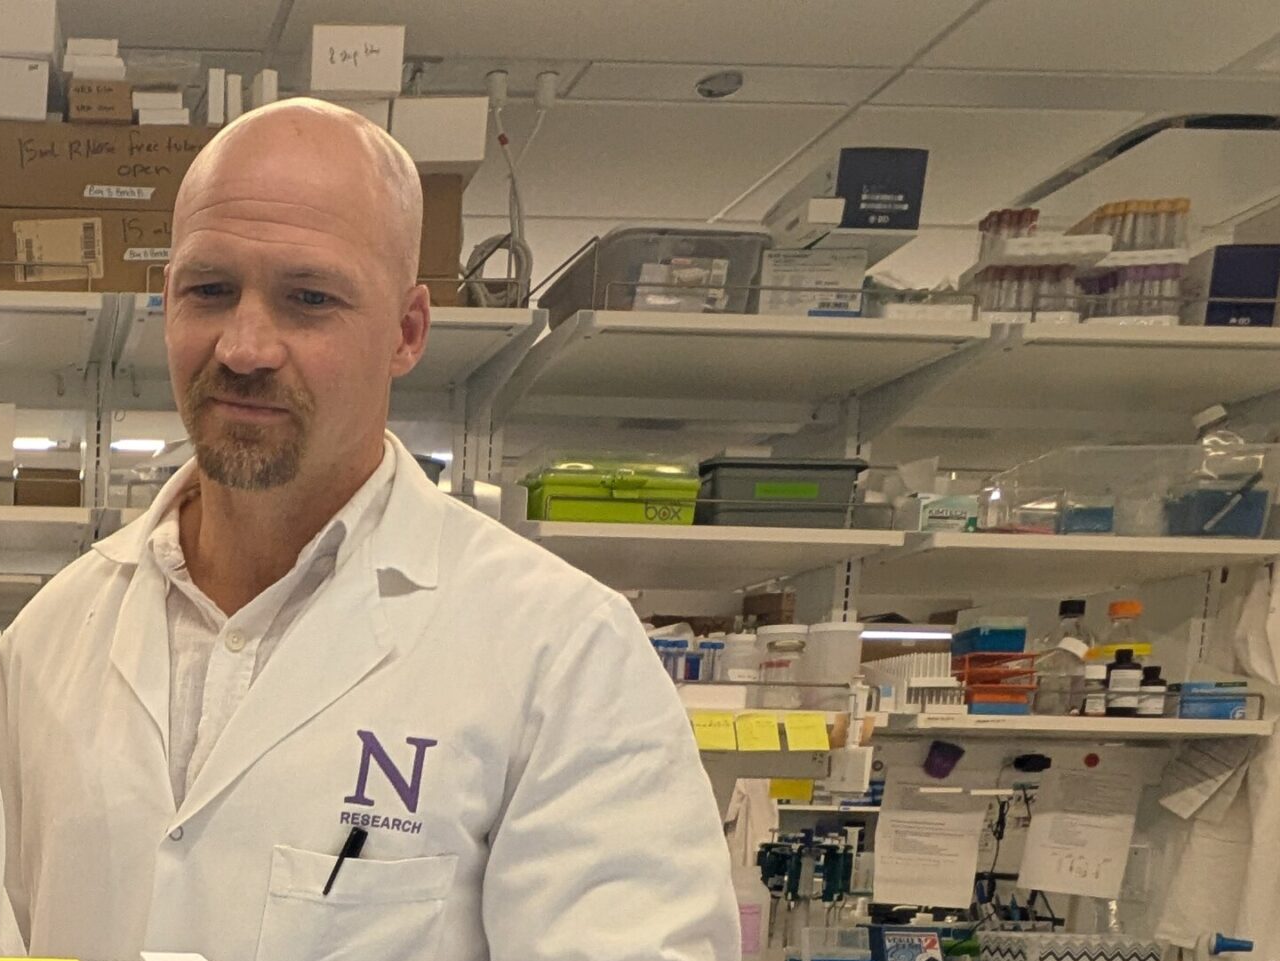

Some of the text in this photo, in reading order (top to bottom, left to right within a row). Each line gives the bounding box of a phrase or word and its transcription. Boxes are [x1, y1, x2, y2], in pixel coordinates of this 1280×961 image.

[117, 163, 170, 178] open
[343, 728, 438, 814] N
[340, 811, 423, 834] RESEARCH
